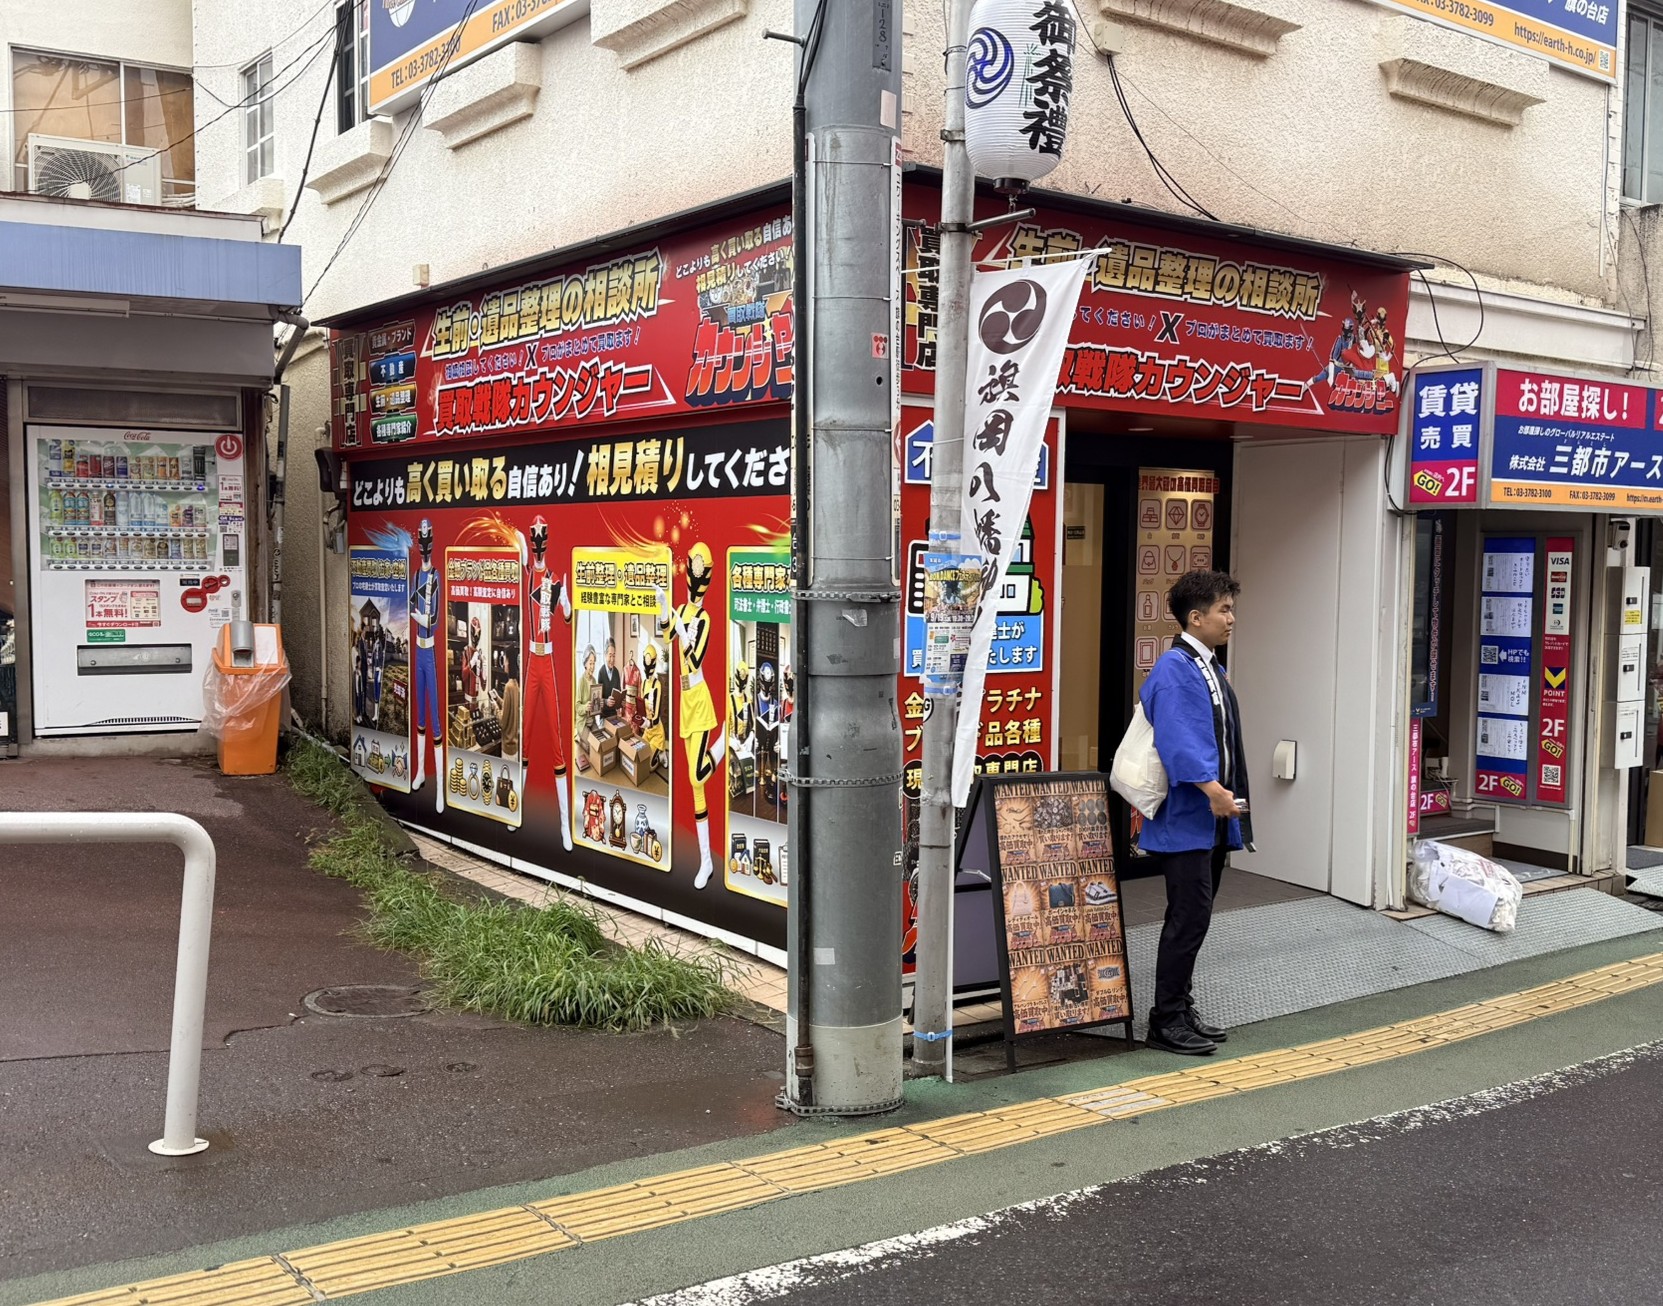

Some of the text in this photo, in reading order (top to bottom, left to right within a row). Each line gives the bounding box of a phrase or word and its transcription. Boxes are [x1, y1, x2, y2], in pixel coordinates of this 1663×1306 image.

[1565, 0, 1610, 25] 旗の台店
[1514, 22, 1597, 65] https://earth-h.co.jp/
[433, 250, 661, 358] 生前・遺品整理の相談所
[380, 361, 404, 377] 不動産
[437, 360, 651, 430] 買取戦隊カウンジャー
[1418, 381, 1479, 418] 賃貸
[1518, 378, 1628, 421] お部屋探し！
[1420, 424, 1473, 450] 売買
[1518, 425, 1615, 442] お部屋探しのグローバルリアルエステート
[1509, 444, 1663, 480] 株式会社 三都市アース
[1417, 474, 1440, 494] GO!
[1445, 466, 1476, 497] 2F
[1550, 557, 1570, 565] VISA
[576, 562, 668, 588] 生前整理・遺品整理
[732, 564, 791, 591] 各種専門家
[90, 595, 117, 603] スタンプ
[87, 603, 128, 618] 1本無料!
[981, 686, 1042, 713] ラチナ
[1541, 718, 1564, 737] 2F
[1543, 741, 1562, 757] GO!
[1031, 781, 1070, 797] WANTED
[1478, 774, 1498, 791] 2F
[1503, 779, 1521, 794] GO!
[1420, 793, 1434, 811] 2F
[1039, 861, 1077, 879] WANTED
[1079, 859, 1115, 876] WANTED
[1046, 943, 1085, 963] WANTED
[1087, 940, 1124, 958] WANTED
